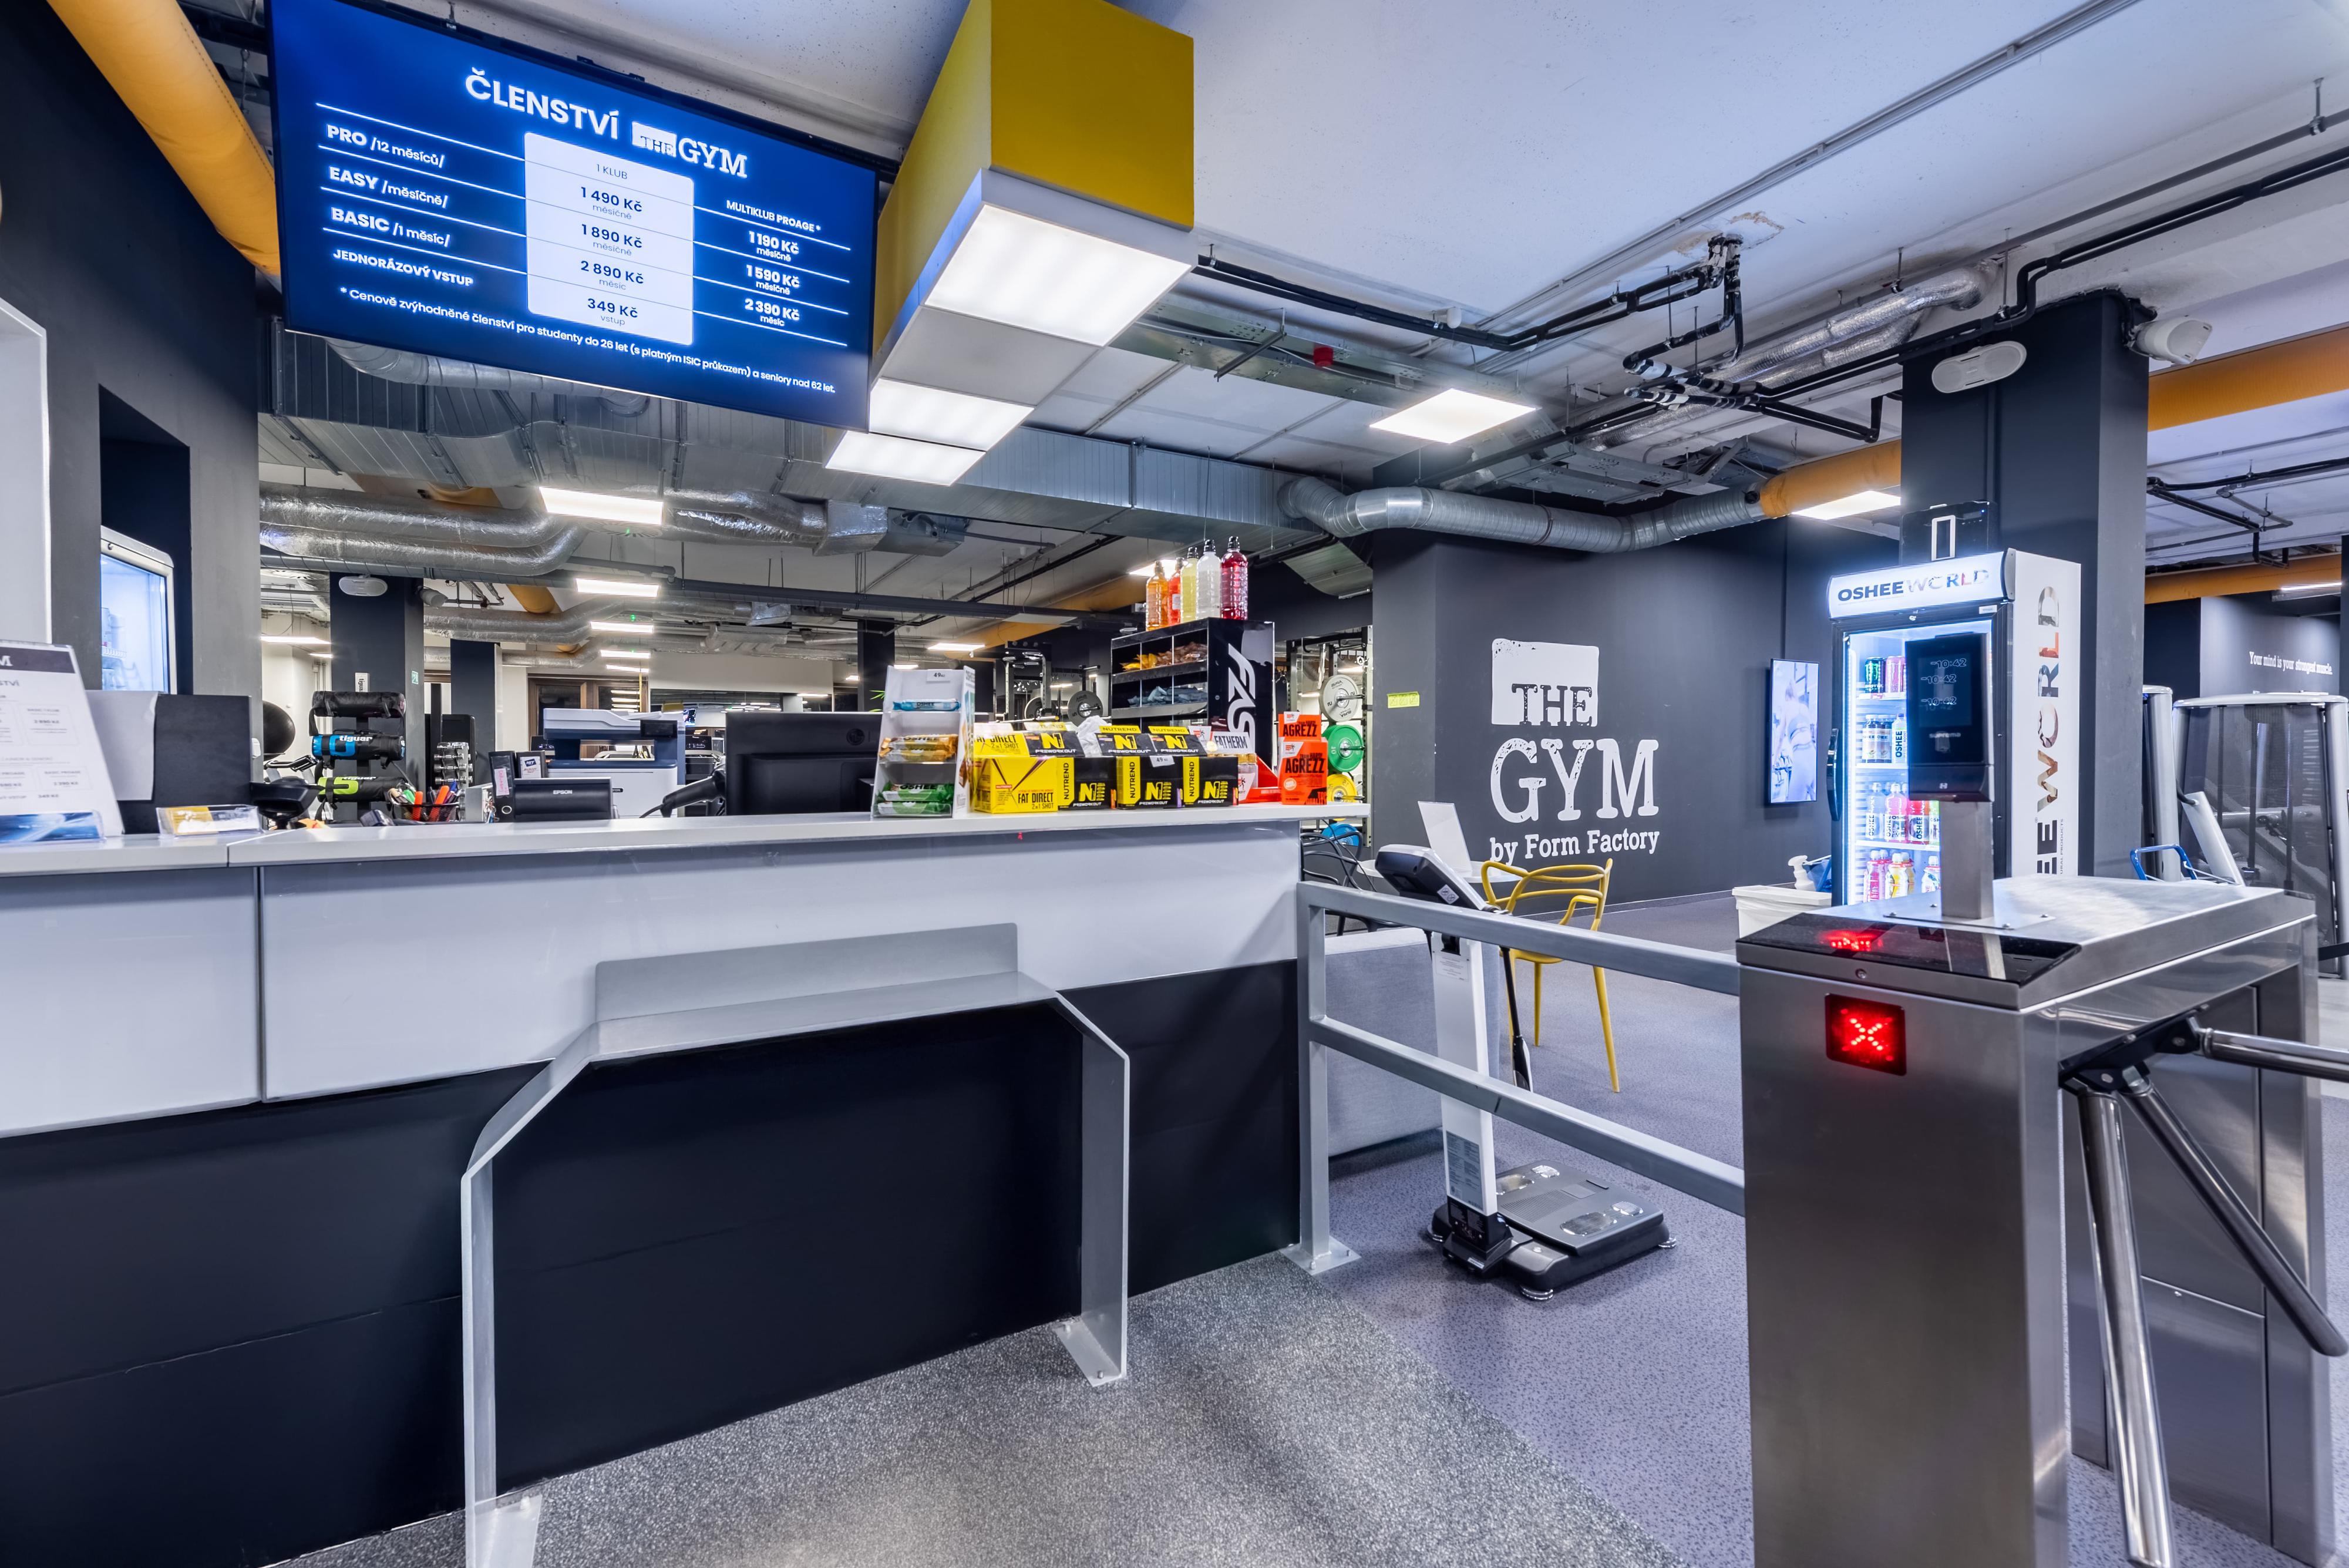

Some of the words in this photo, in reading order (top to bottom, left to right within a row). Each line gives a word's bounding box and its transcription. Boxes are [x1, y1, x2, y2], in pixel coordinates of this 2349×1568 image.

[465, 66, 618, 140] ČLENSTVÍ
[640, 135, 675, 157] THE
[678, 138, 748, 178] GYM
[327, 125, 366, 146] PRO
[370, 137, 389, 152] /12
[392, 144, 445, 169] měsíců/
[603, 165, 628, 180] KLUB
[329, 166, 379, 190] EASY
[381, 180, 448, 208] /měsíčně/
[581, 187, 586, 198] 1
[590, 189, 619, 206] 490
[623, 194, 642, 213] Kč
[592, 203, 632, 220] měsíčně
[726, 200, 776, 222] MULTIKLUB
[331, 207, 389, 232] BASIC
[405, 227, 450, 247] měsíc/
[581, 224, 587, 235] 1
[590, 226, 620, 243] 890
[624, 231, 642, 248] Kč
[593, 240, 632, 257] měsíčně
[756, 245, 792, 263] měsíčně
[781, 238, 799, 255] Kč
[333, 249, 432, 278] JEDNORÁZOVÝ
[432, 268, 474, 287] VSTUP
[580, 260, 590, 272] 2
[593, 263, 621, 279] 890
[625, 268, 644, 285] Kč
[746, 265, 752, 277] 1
[753, 267, 780, 284] 590
[782, 271, 800, 288] Kč
[599, 277, 626, 291] měsíc
[756, 280, 790, 295] měsíčně
[587, 298, 615, 314] 349
[619, 303, 638, 319] Kč
[745, 298, 752, 311] 2
[753, 300, 780, 317] 390
[782, 305, 800, 321] Kč
[600, 315, 625, 327] vstup
[760, 315, 785, 327] měsíc
[399, 300, 470, 321] zvýhodněné
[472, 313, 515, 330] členství
[517, 322, 535, 334] pro
[537, 327, 583, 345] studenty
[585, 337, 599, 348] do
[600, 339, 614, 350] 26
[615, 342, 628, 353] let
[630, 343, 640, 356] (s
[641, 346, 682, 364] platným
[683, 355, 701, 367] ISIC
[702, 357, 751, 378] průkazem)
[760, 371, 792, 386] seniory
[793, 376, 810, 389] nad
[811, 380, 822, 391] 62
[2249, 651, 2263, 665] Your
[2263, 654, 2276, 667] mind
[2277, 656, 2282, 668] is
[2283, 659, 2294, 671] your
[2295, 659, 2316, 674] strongest
[1512, 684, 1593, 726] THE
[1283, 724, 1317, 737] AGREZZ
[1285, 758, 1325, 773] AGREZZ
[1490, 738, 1659, 823] GYM
[1018, 793, 1029, 804] FAT
[1032, 792, 1054, 803] DIRECT
[1490, 837, 1518, 866] by
[1525, 834, 1580, 859] Form
[1587, 829, 1660, 854] Factory
